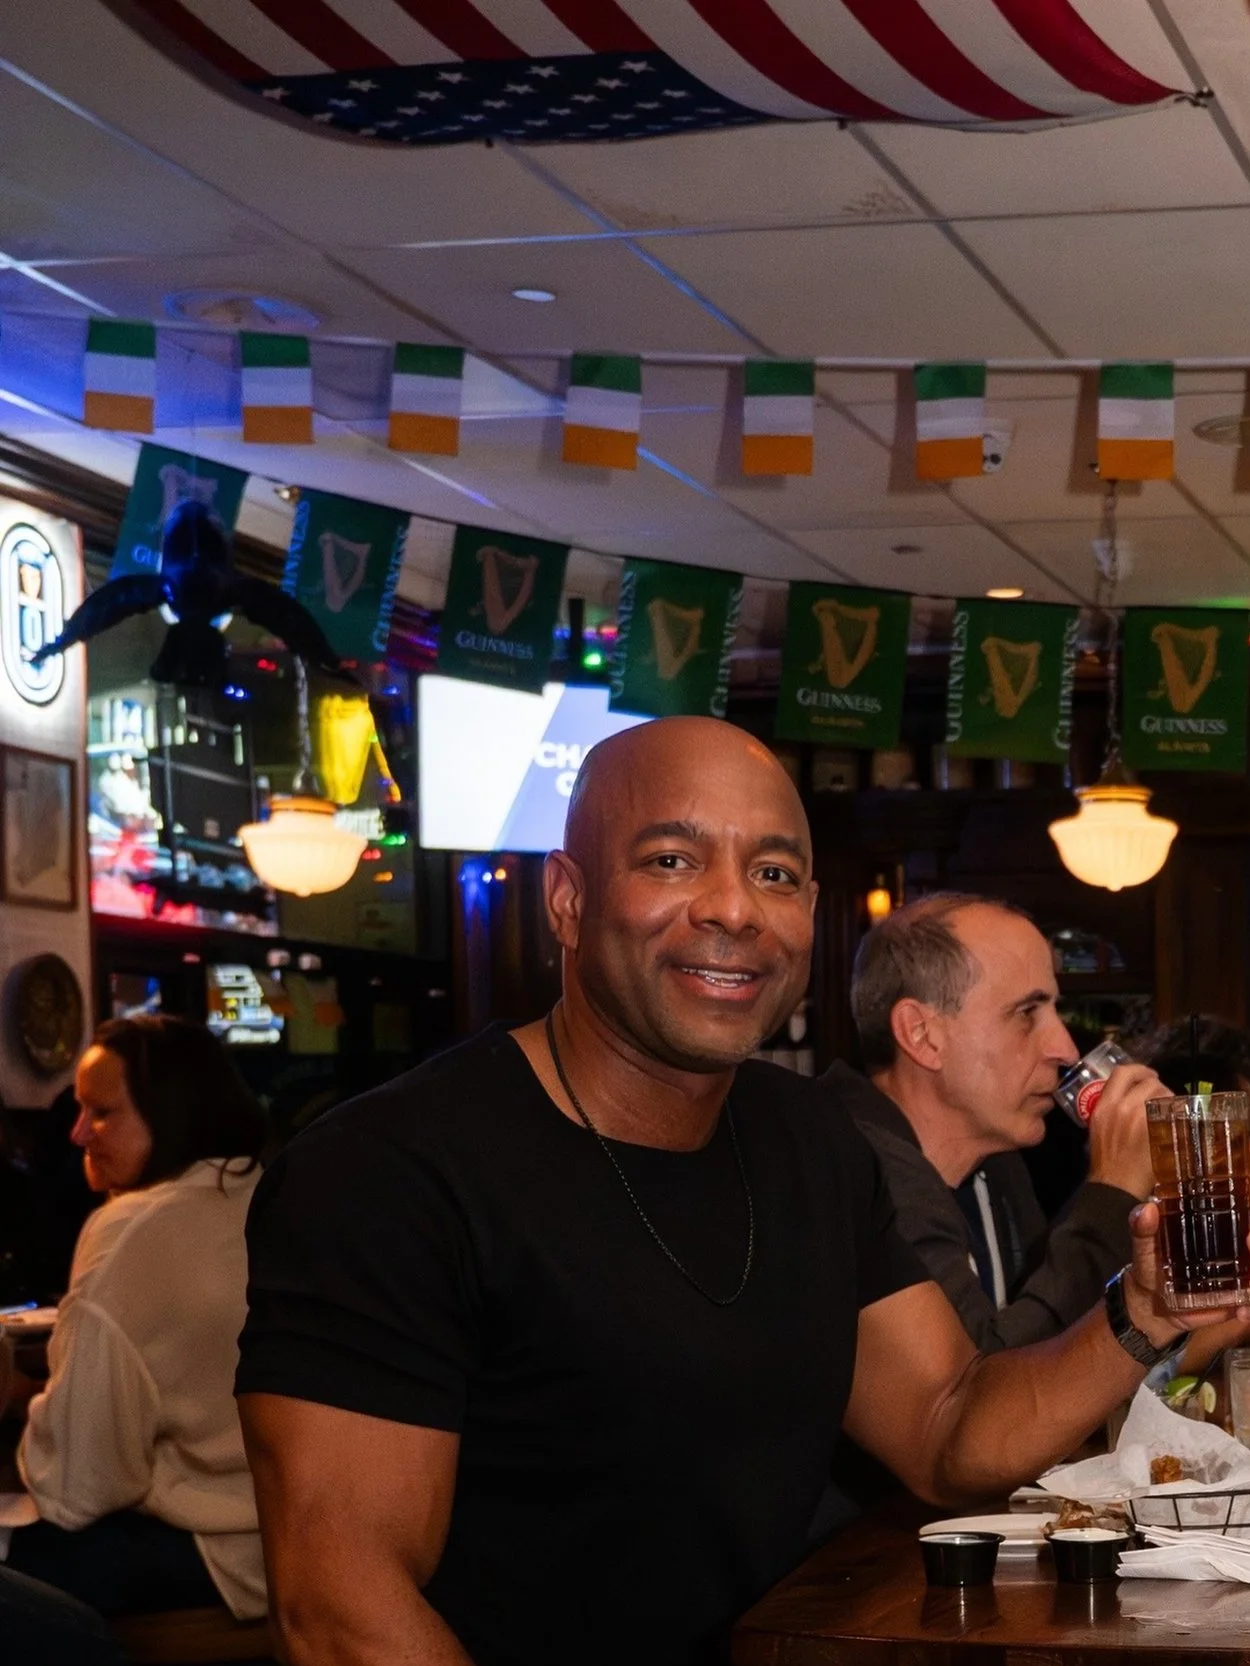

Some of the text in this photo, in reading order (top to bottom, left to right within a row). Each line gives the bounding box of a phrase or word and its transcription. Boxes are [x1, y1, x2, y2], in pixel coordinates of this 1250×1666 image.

[455, 630, 534, 660] GUINNESS
[945, 611, 970, 744] GUINNESS
[797, 687, 882, 714] GUINNESS
[1140, 714, 1228, 735] GUINNESS
